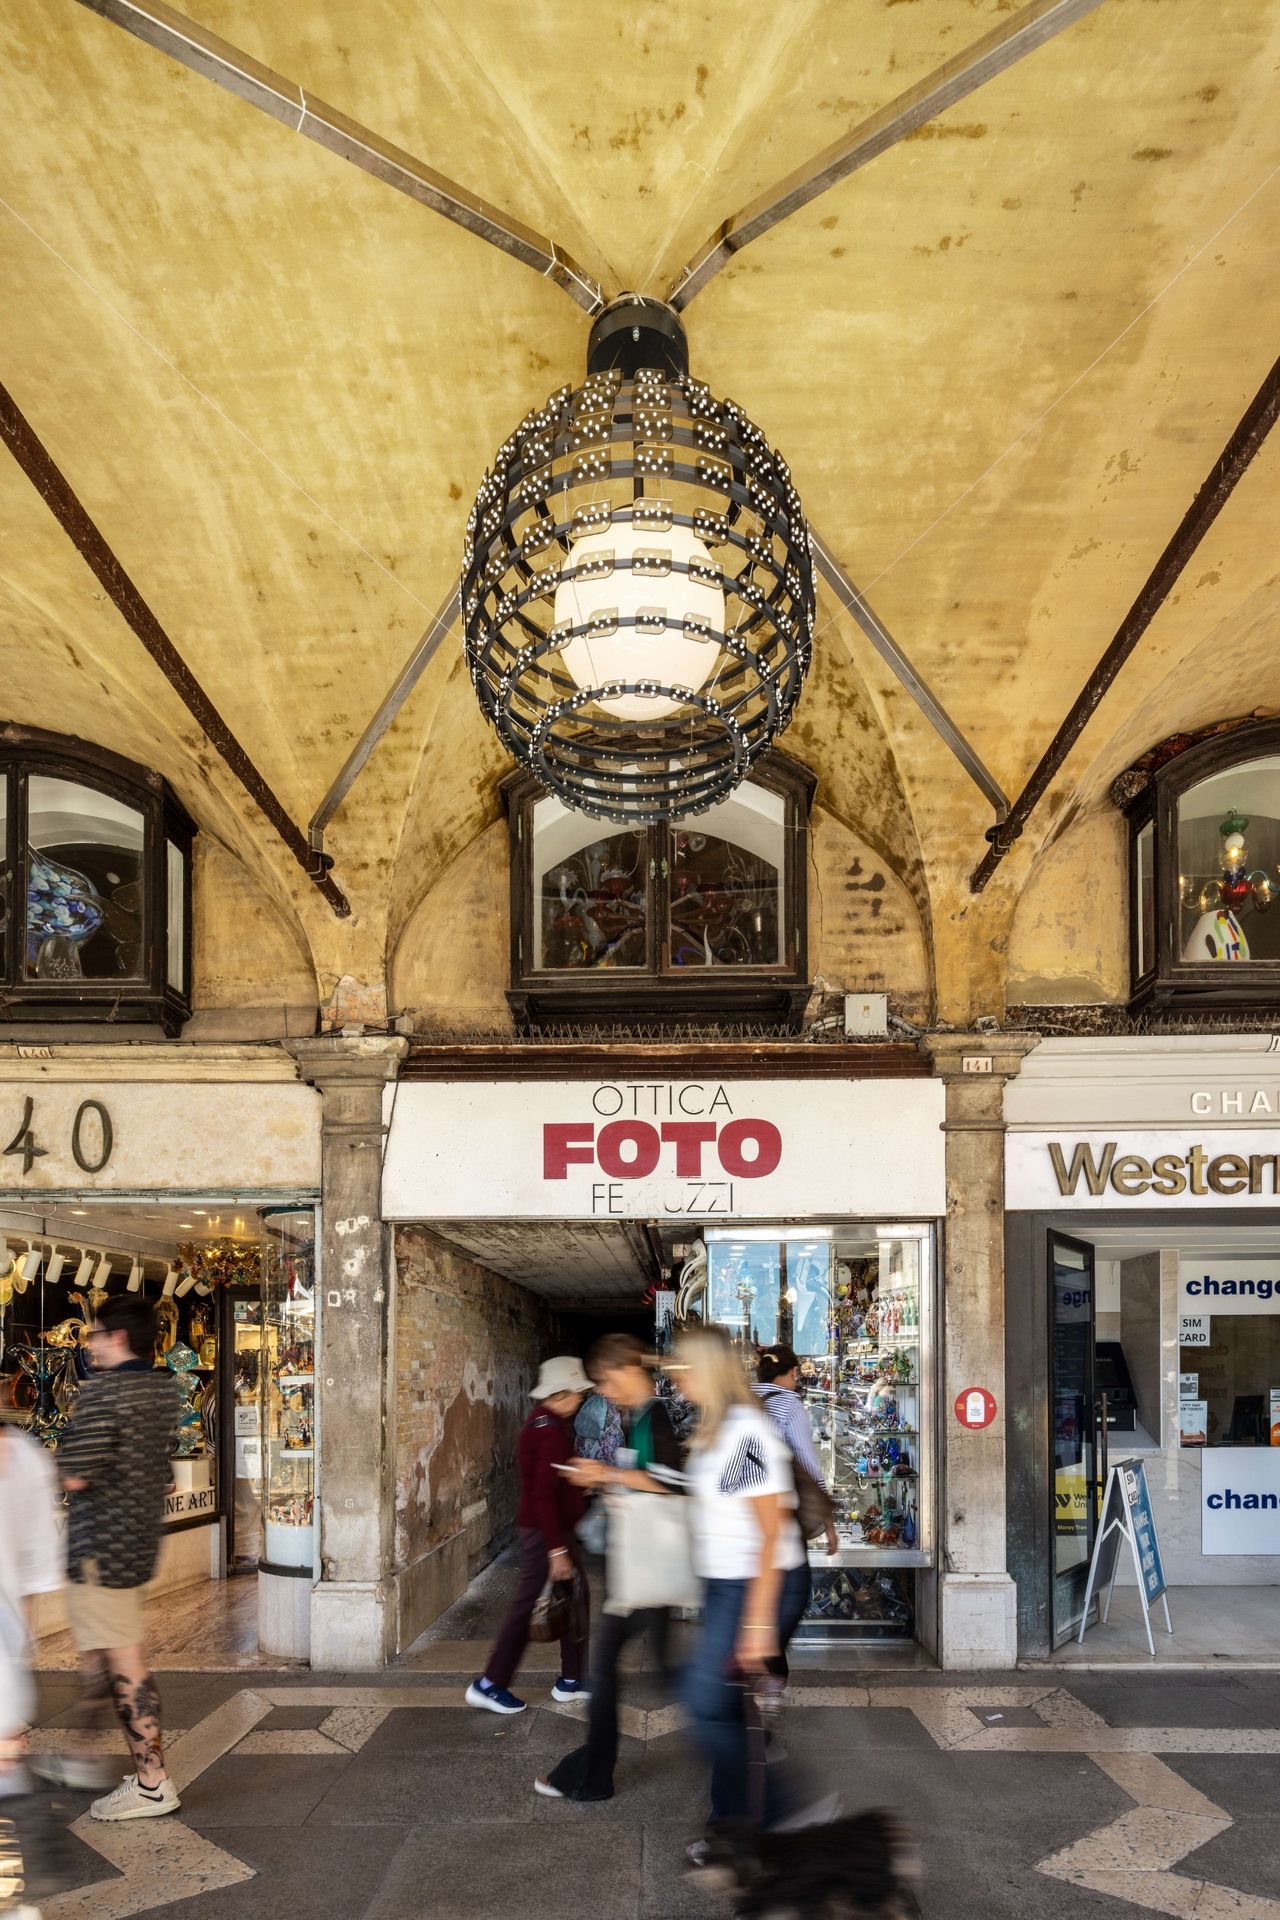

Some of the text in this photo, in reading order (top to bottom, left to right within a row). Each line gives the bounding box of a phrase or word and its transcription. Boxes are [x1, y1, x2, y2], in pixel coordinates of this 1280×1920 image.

[965, 1059, 991, 1072] 141
[592, 1084, 734, 1116] OTTICA
[1191, 1090, 1280, 1114] CHA
[2, 1096, 114, 1175] 40
[543, 1118, 783, 1179] FOTO
[592, 1182, 734, 1213] FEZZI
[1182, 1318, 1202, 1328] SIM
[1179, 1333, 1207, 1342] CARD
[187, 1489, 216, 1511] ART
[1206, 1488, 1280, 1510] chan
